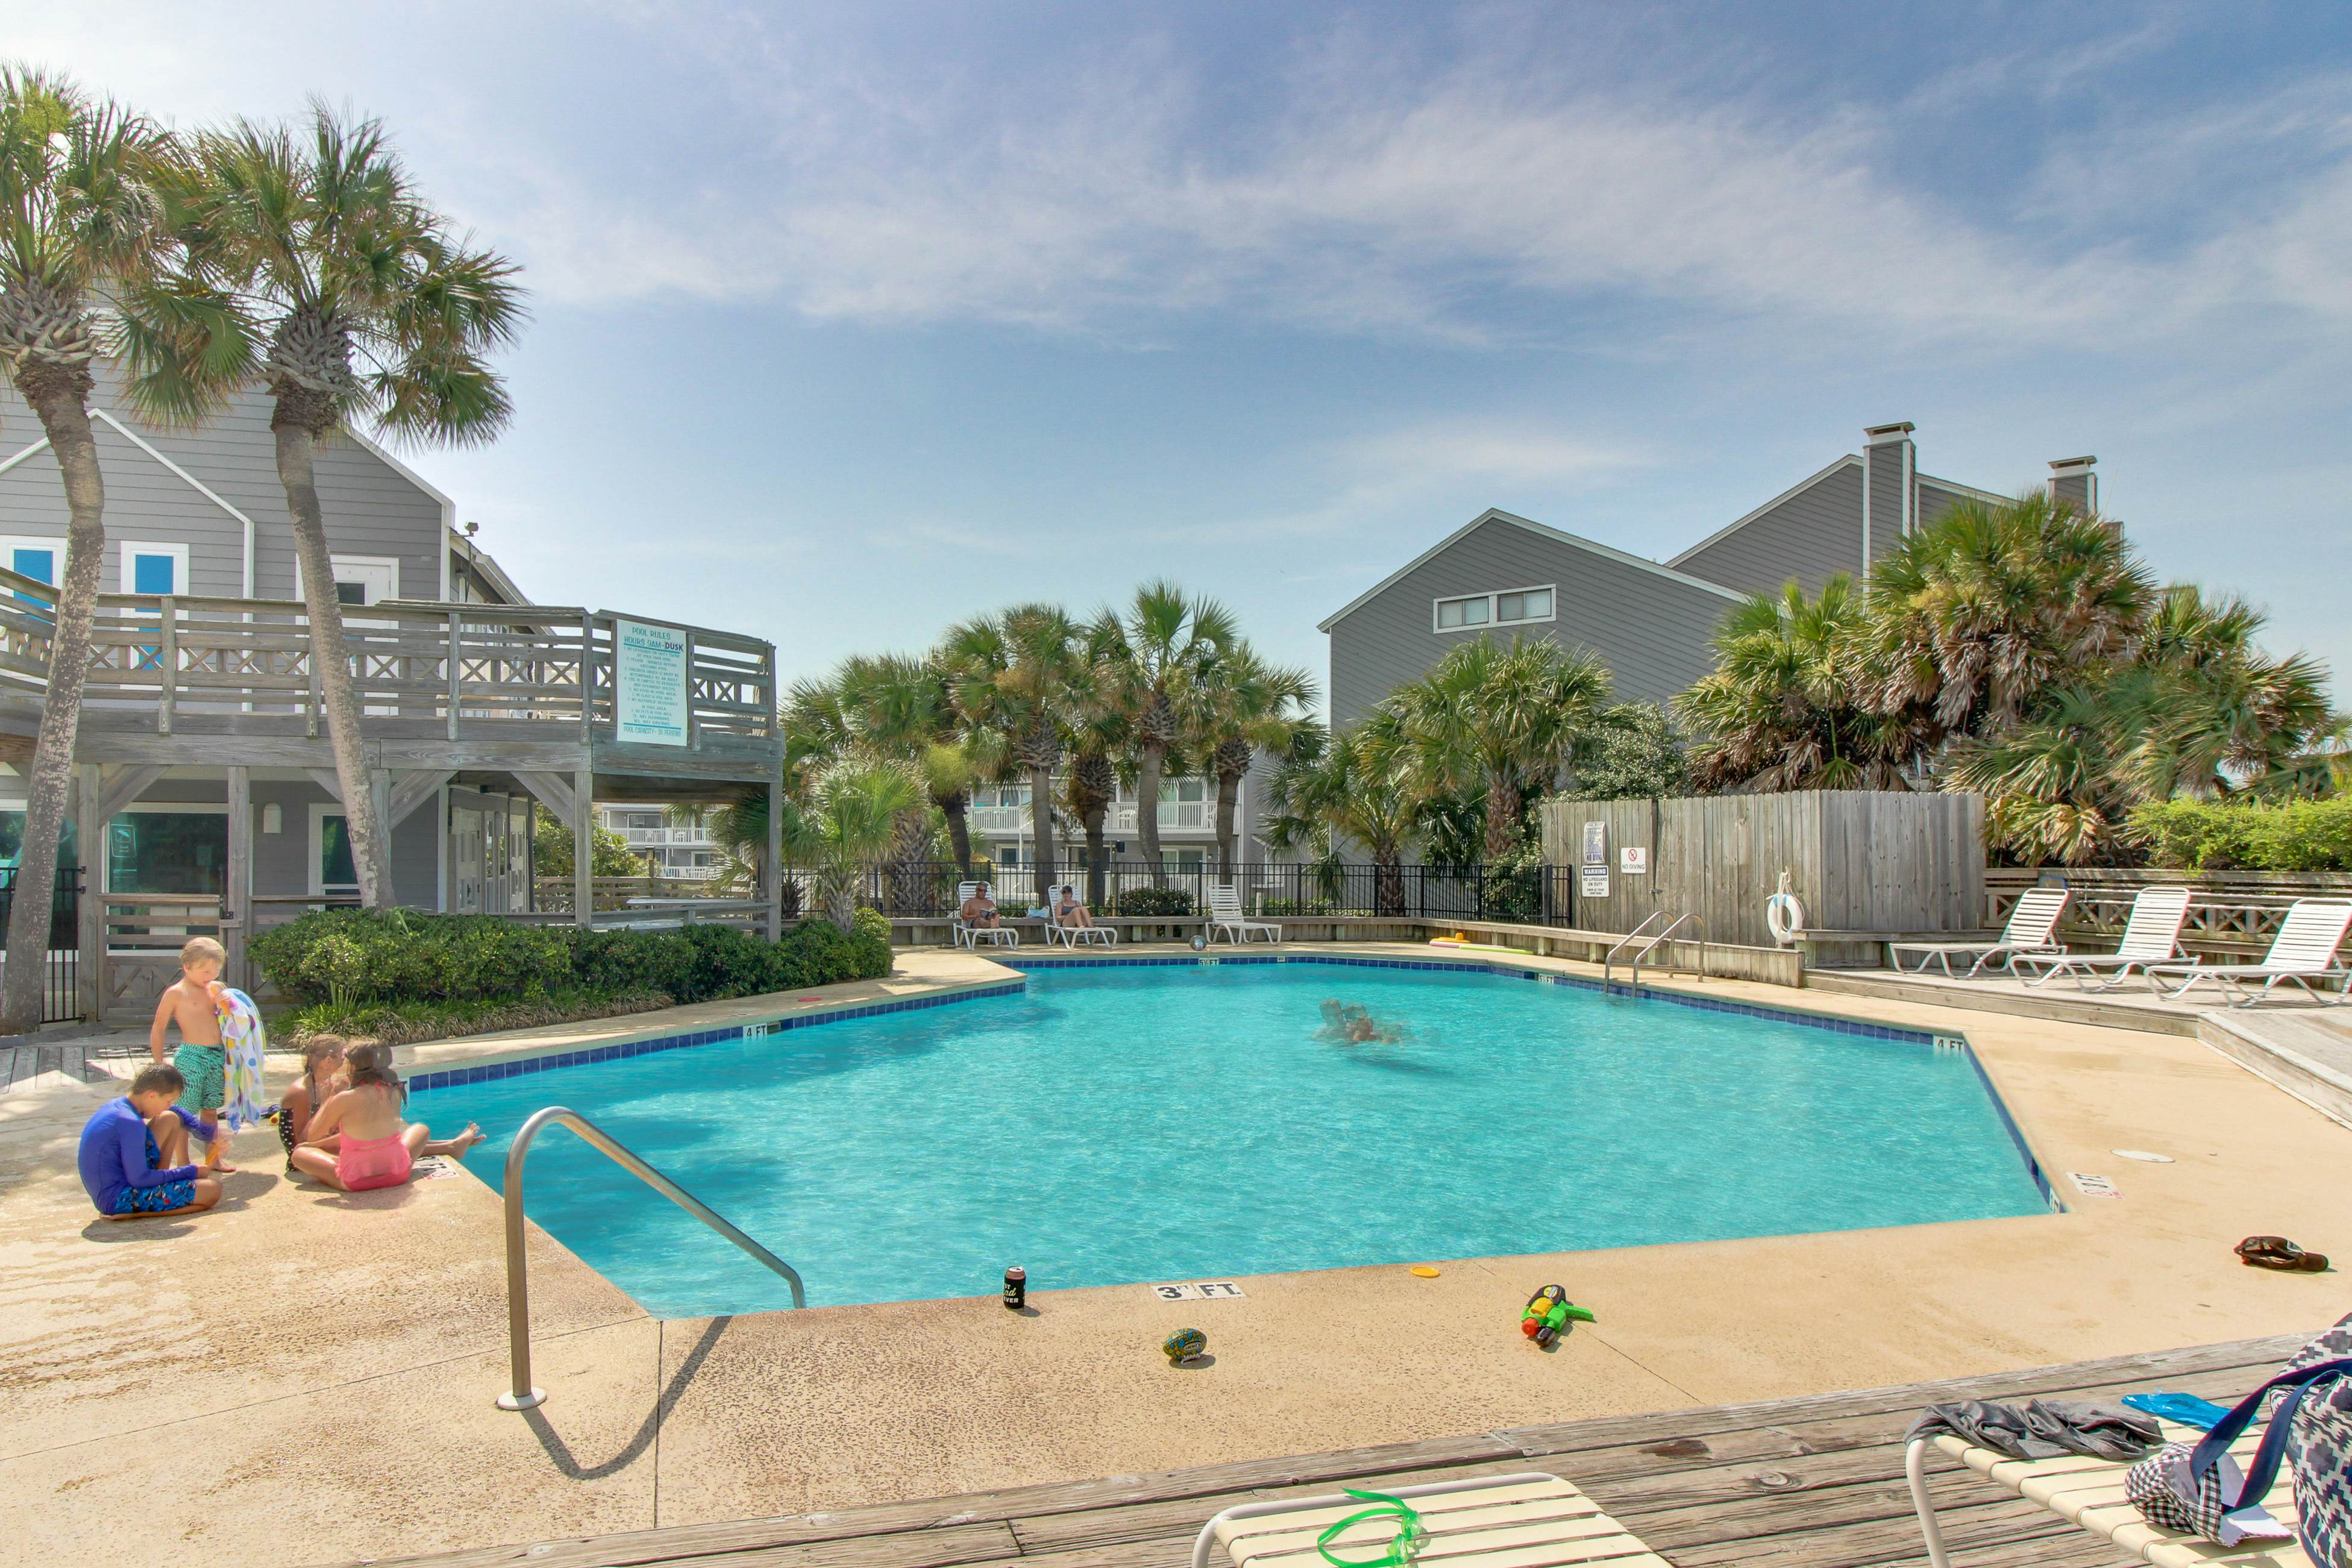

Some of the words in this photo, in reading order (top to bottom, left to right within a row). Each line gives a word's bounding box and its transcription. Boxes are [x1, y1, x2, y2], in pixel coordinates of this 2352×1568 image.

[632, 627, 648, 636] POOL
[650, 630, 671, 640] RULES
[624, 636, 645, 645] HOURS
[747, 1027, 751, 1036] 4
[756, 1025, 765, 1036] FT
[1950, 1040, 1963, 1050] FT
[1158, 1287, 1182, 1298] 3
